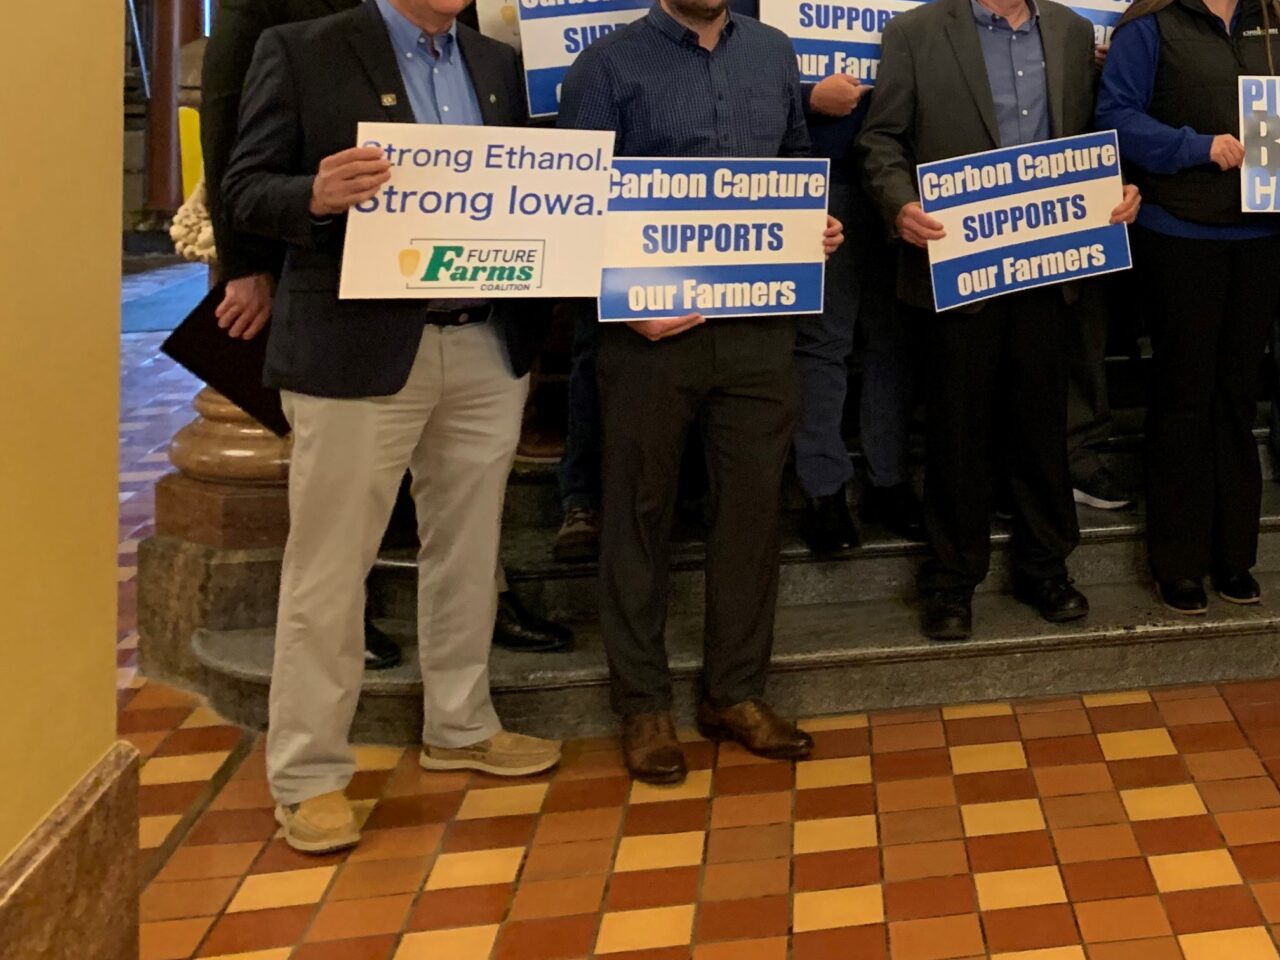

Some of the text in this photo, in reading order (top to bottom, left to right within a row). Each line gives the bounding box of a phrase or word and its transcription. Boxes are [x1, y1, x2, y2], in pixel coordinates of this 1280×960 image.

[485, 144, 608, 171] Ethanol.
[922, 143, 1116, 201] Carbon Capture
[608, 168, 825, 200] Carbon Capture
[508, 185, 603, 216] Iowa.
[962, 193, 1087, 243] SUPPORTS
[642, 222, 784, 254] SUPPORTS
[420, 245, 534, 282] Farms
[466, 249, 537, 263] FUTURE
[957, 243, 1106, 297] our Farmers
[627, 279, 797, 312] our Farmers
